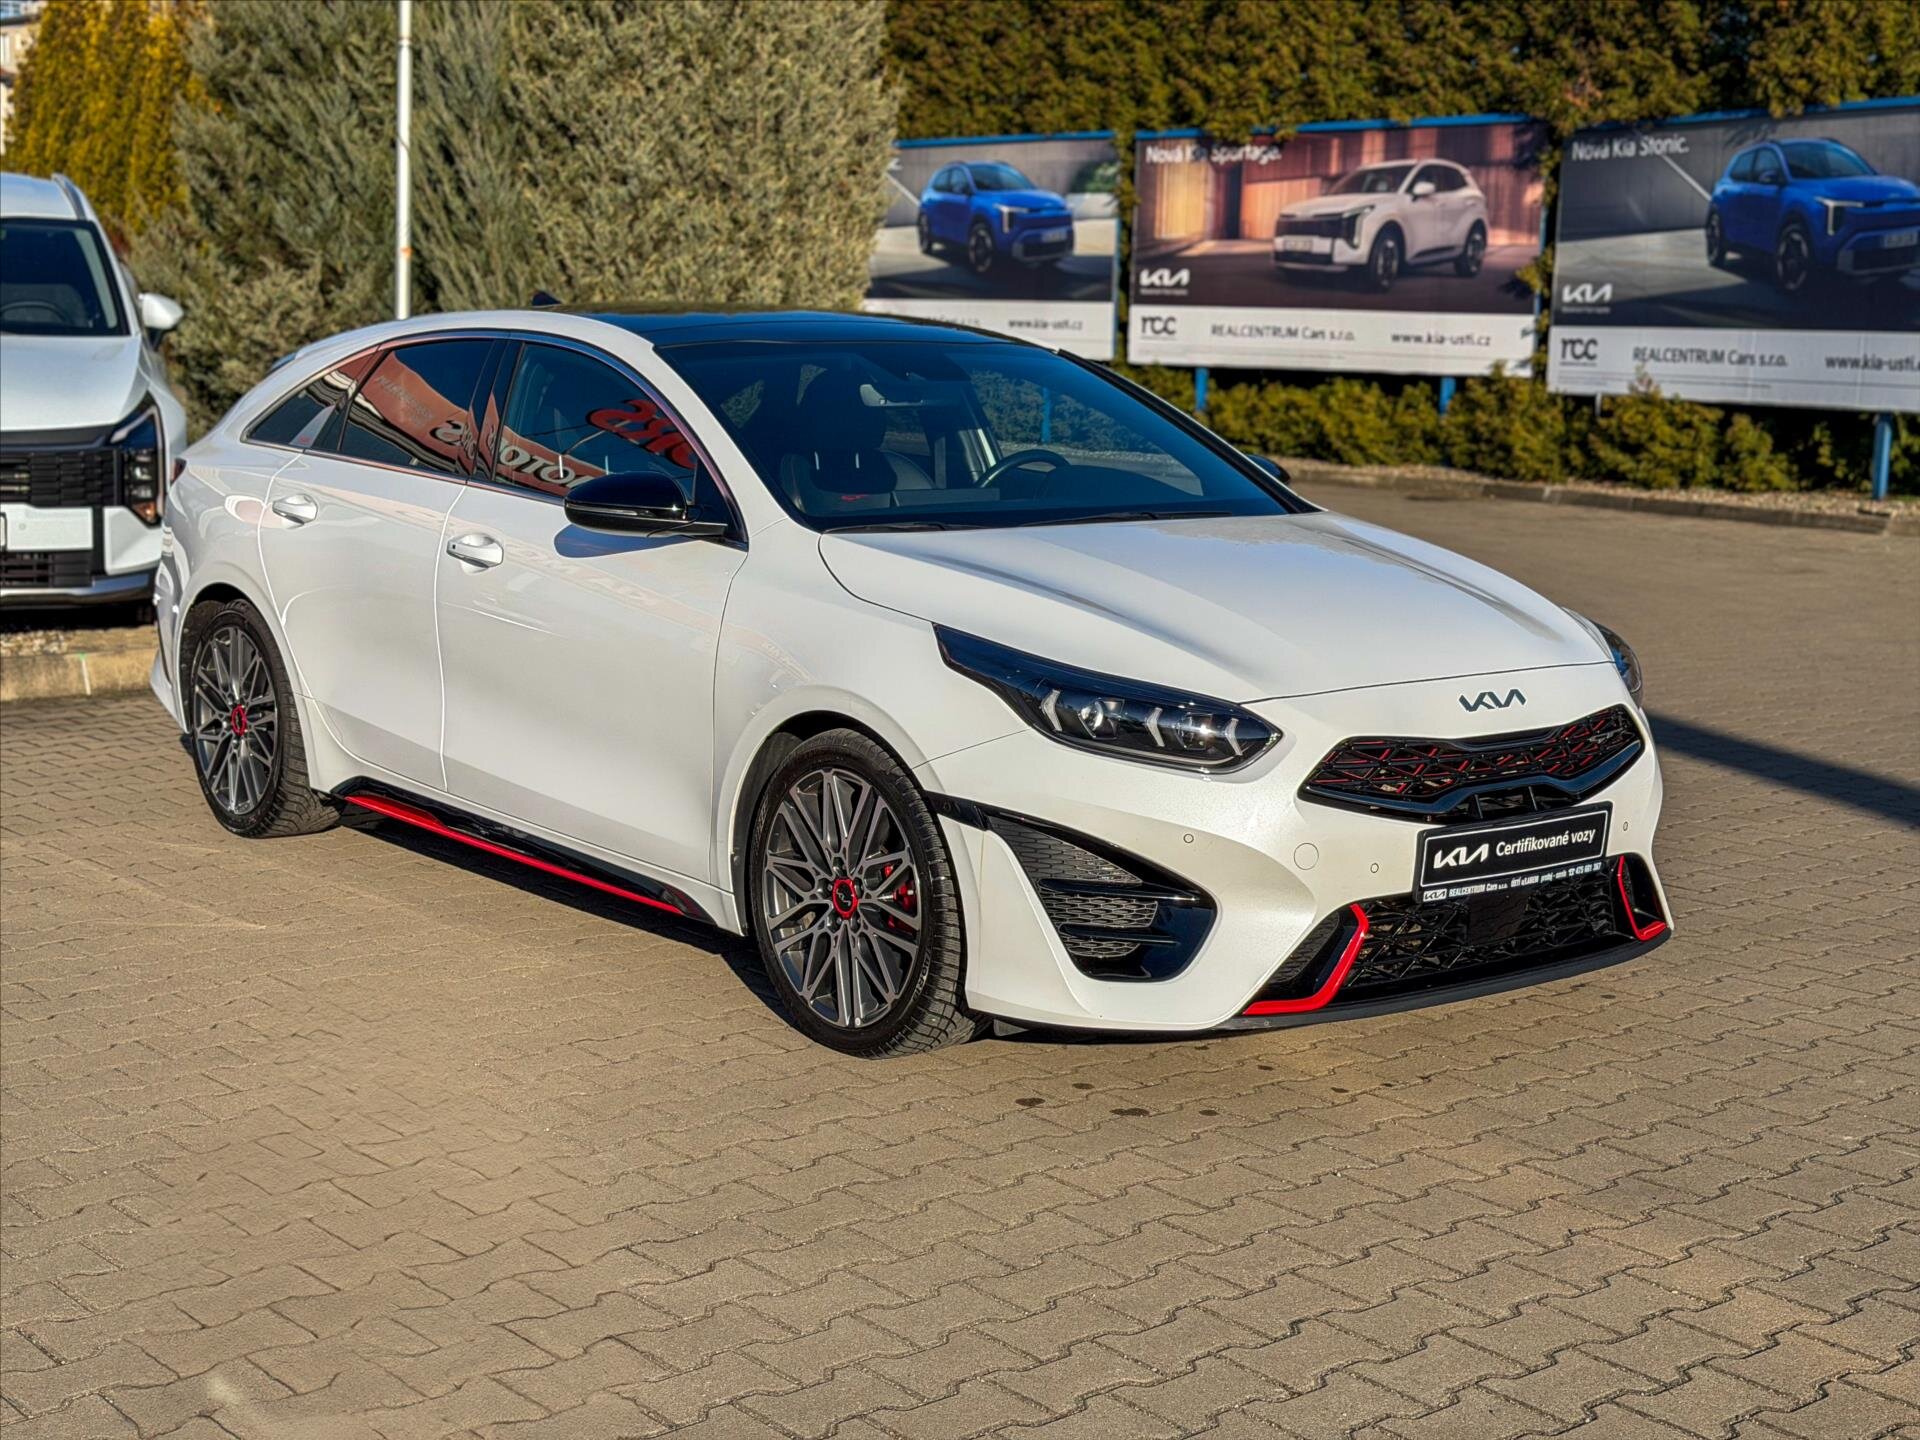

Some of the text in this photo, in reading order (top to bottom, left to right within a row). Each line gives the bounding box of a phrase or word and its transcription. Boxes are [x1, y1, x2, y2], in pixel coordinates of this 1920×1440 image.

[1572, 133, 1690, 160] Nová Kia Stonic.
[1139, 267, 1191, 287] KIA
[1562, 283, 1614, 303] KIA
[1210, 323, 1299, 339] REALCENTRUM
[1301, 326, 1326, 341] Cars
[1391, 330, 1491, 347] www.kia-usti.cz
[1632, 346, 1789, 369] REALCENTRUM Cars s.r.o.
[1824, 352, 1920, 372] www.kia-usti.
[1458, 688, 1527, 713] KIA
[1433, 829, 1596, 869] KIA Certifikované vozy
